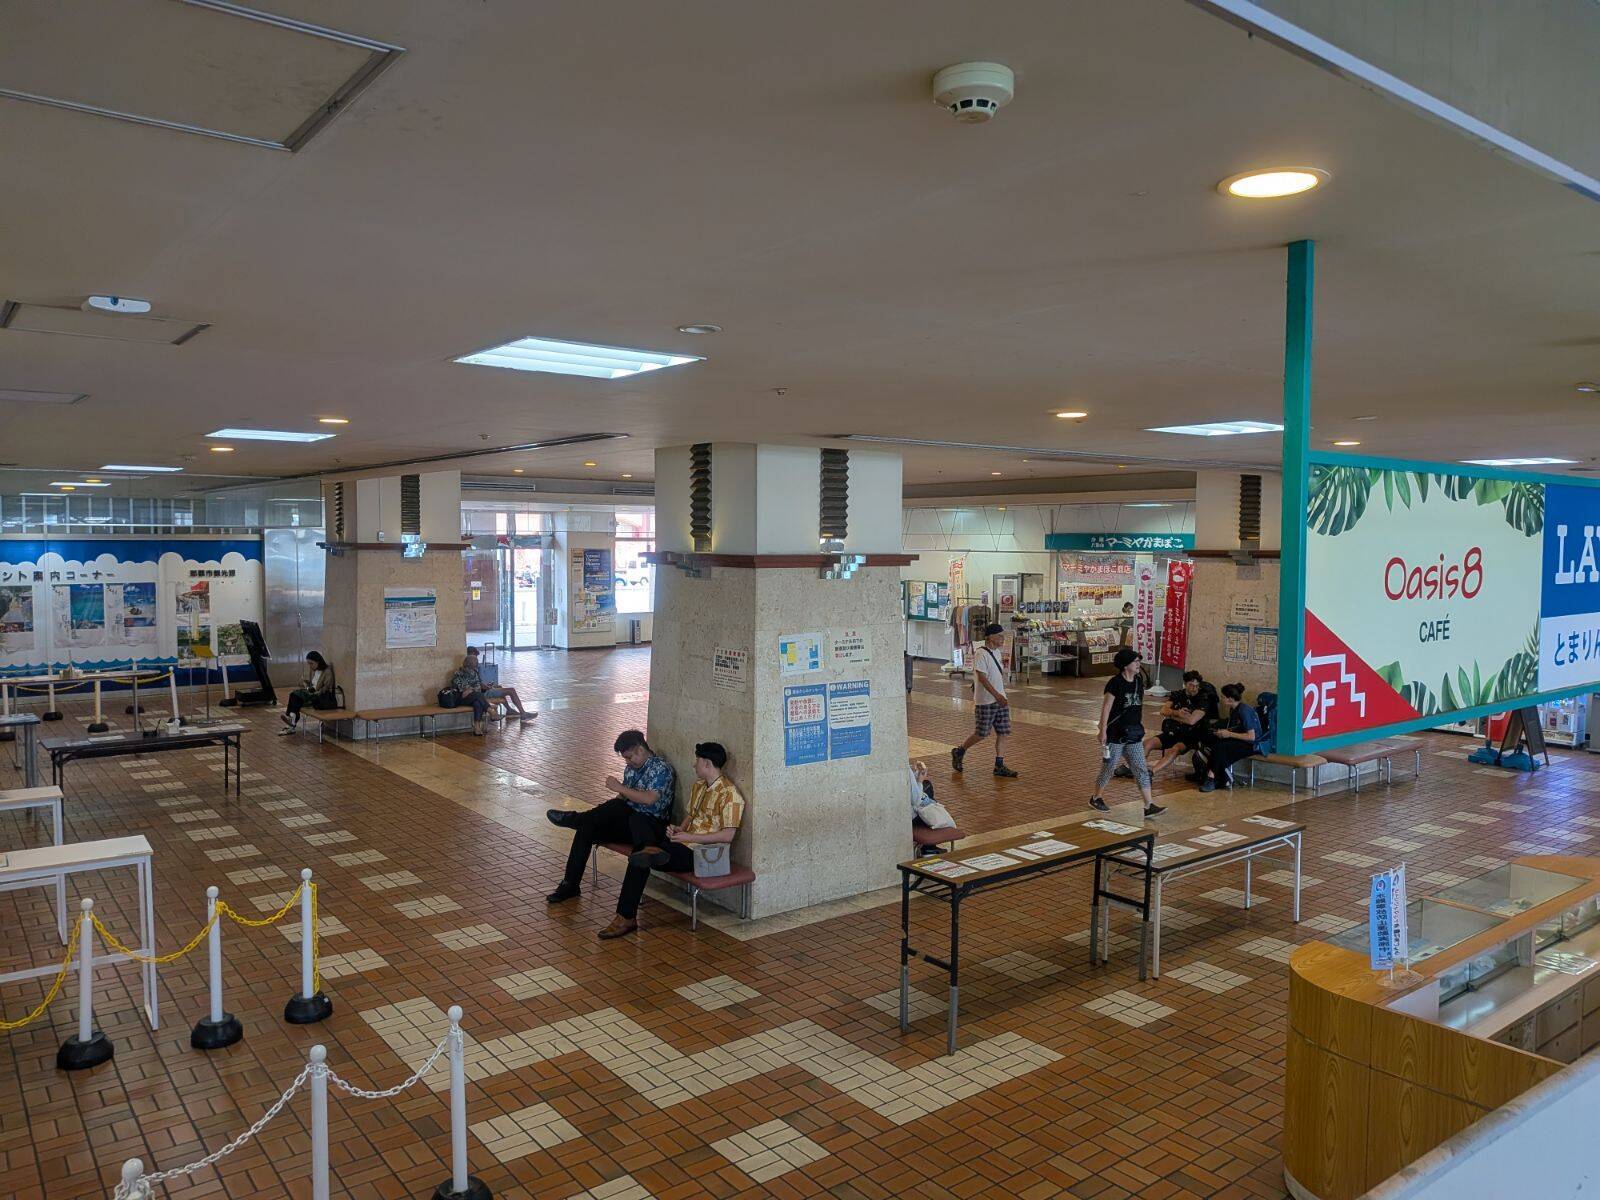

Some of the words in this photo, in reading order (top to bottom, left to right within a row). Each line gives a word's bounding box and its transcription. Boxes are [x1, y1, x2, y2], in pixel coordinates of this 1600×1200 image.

[1105, 537, 1184, 549] マーミヤかまぼこ
[1555, 525, 1600, 585] LA
[1384, 546, 1484, 601] Oasis8
[1136, 622, 1146, 658] Cak
[1418, 613, 1451, 643] CAFÉ
[836, 681, 869, 691] WARNING
[1302, 680, 1337, 729] 2F
